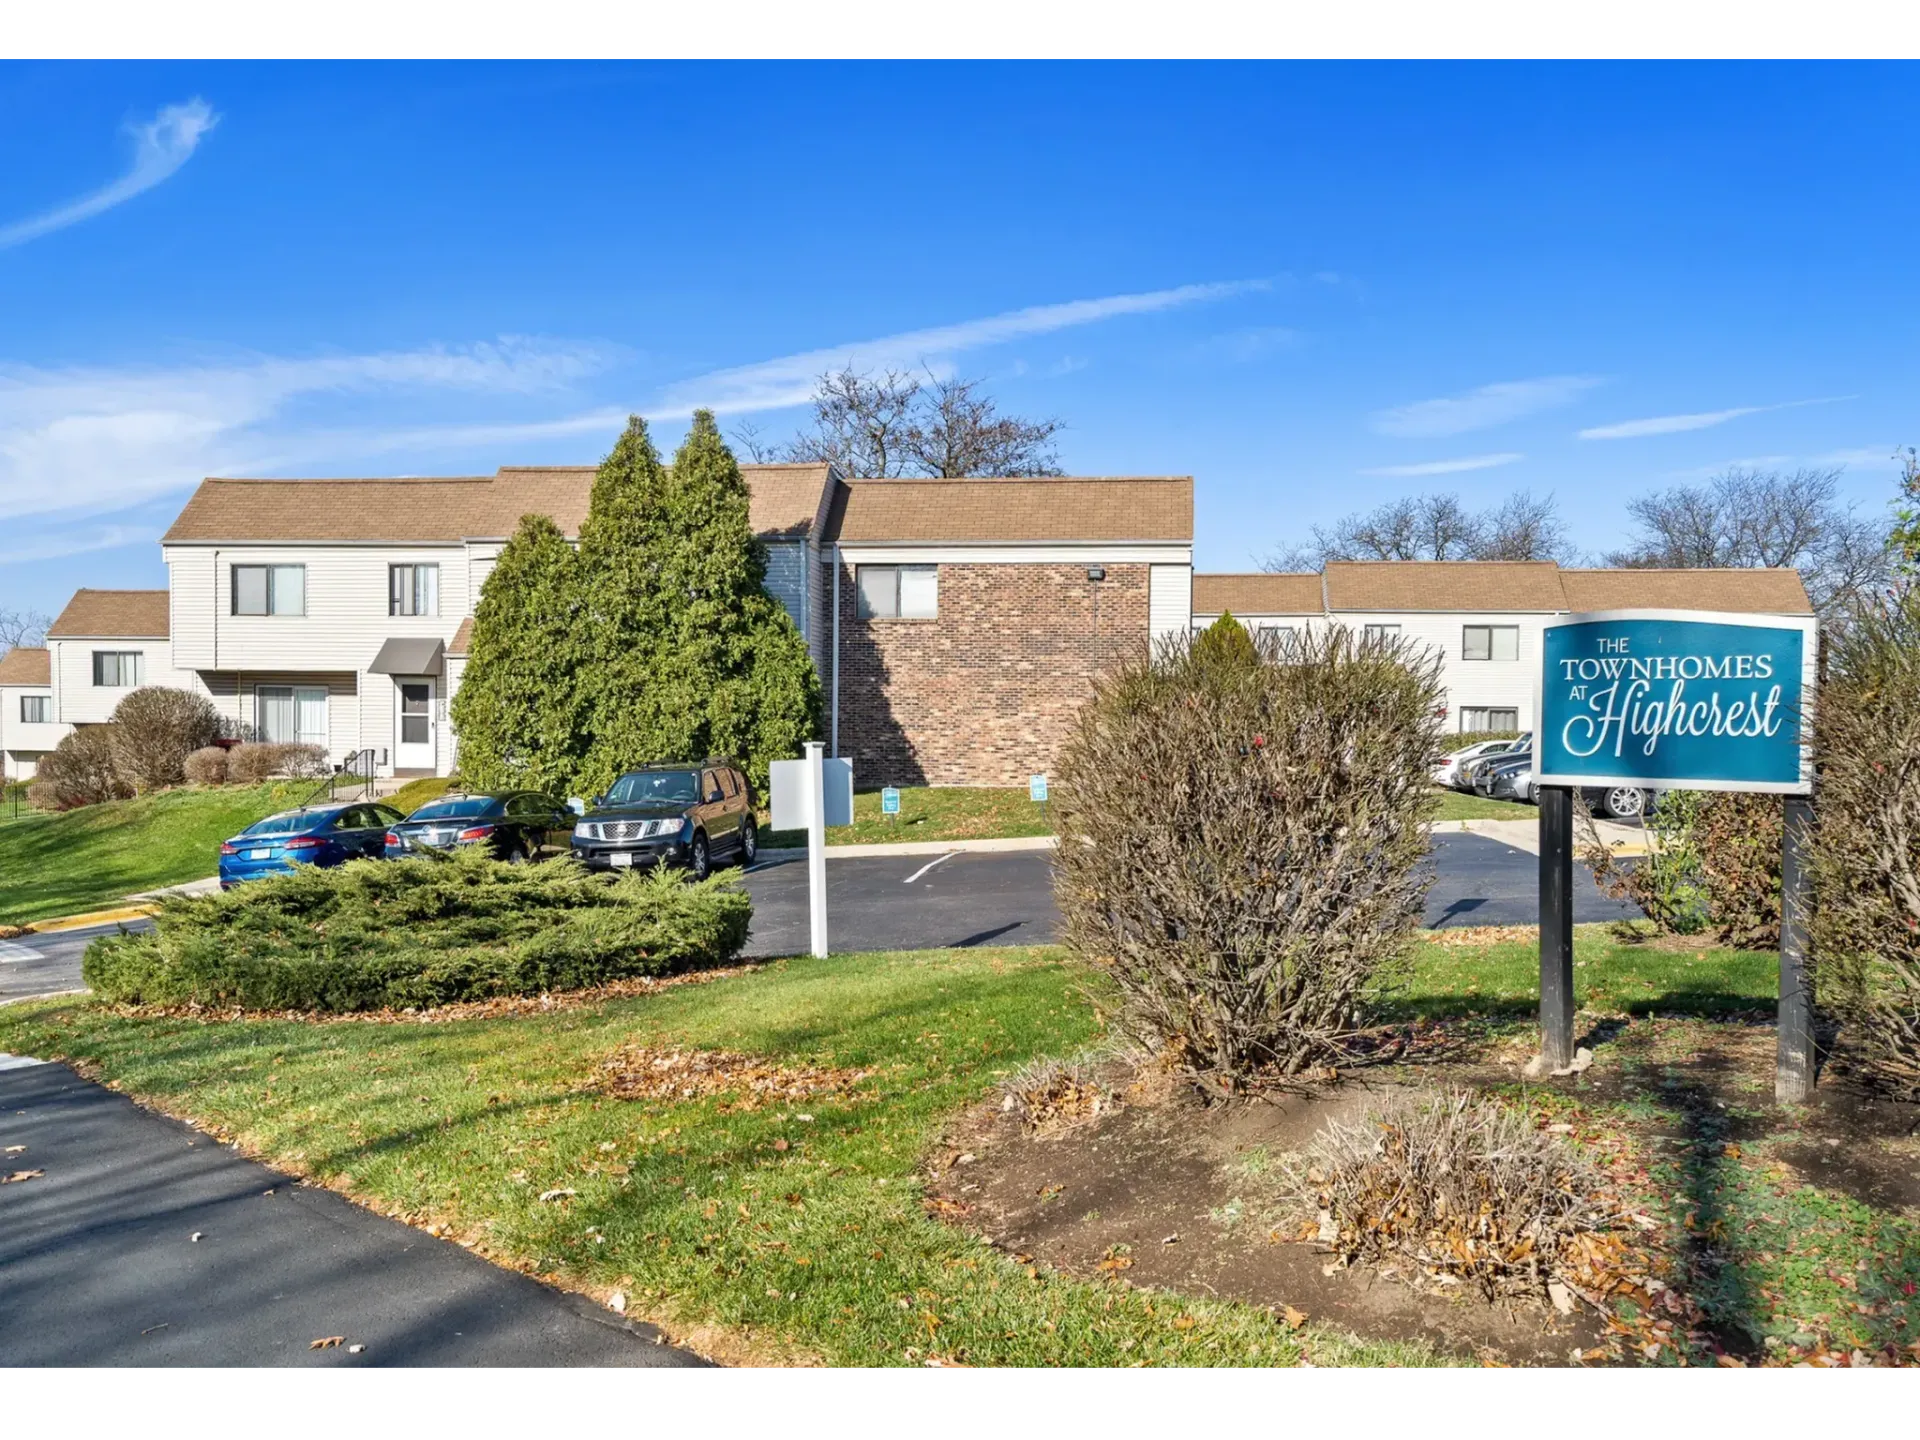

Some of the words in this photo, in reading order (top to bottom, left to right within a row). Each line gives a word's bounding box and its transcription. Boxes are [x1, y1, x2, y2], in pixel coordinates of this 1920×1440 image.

[1597, 637, 1629, 653] THE
[1560, 655, 1772, 681] TOWNHOMES
[1569, 685, 1588, 700] AT
[1562, 679, 1782, 757] Highcrest
